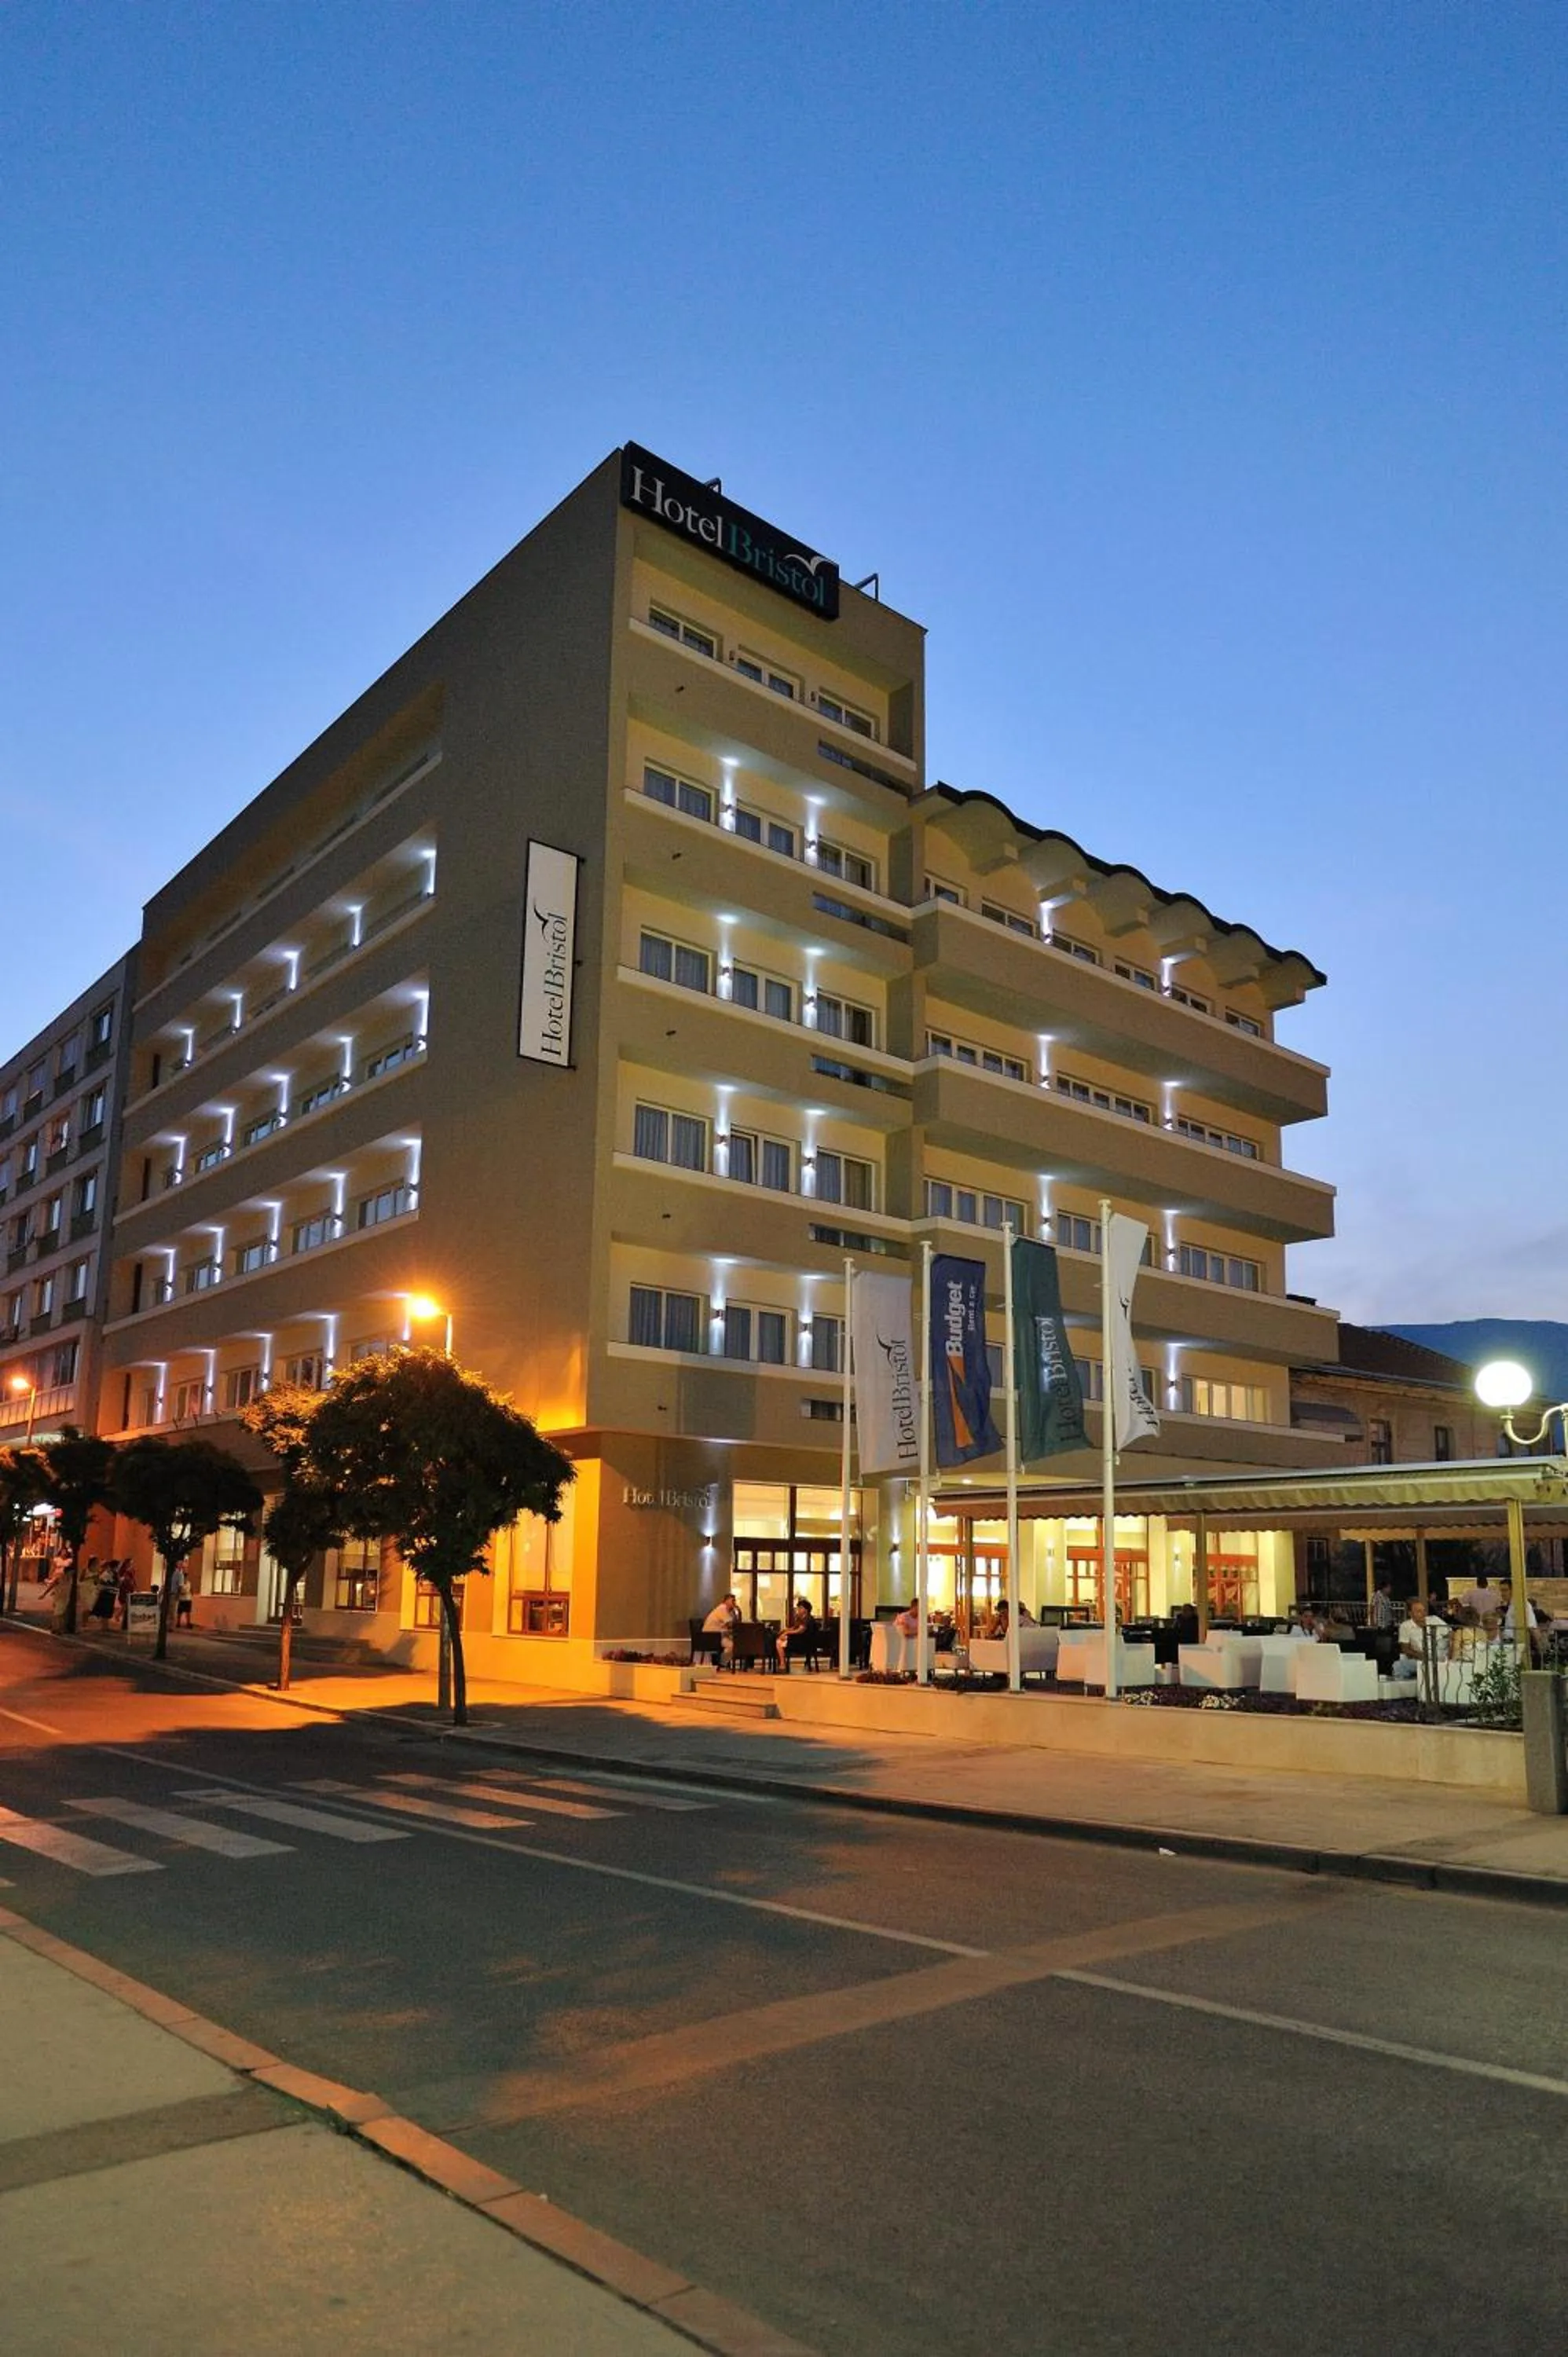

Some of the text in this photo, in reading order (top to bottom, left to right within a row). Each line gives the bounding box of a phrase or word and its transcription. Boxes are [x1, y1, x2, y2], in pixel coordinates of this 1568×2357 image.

[631, 465, 825, 607] Hotel Bristol
[944, 1279, 965, 1357] Budget
[622, 1486, 714, 1509] Hotl Bristo
